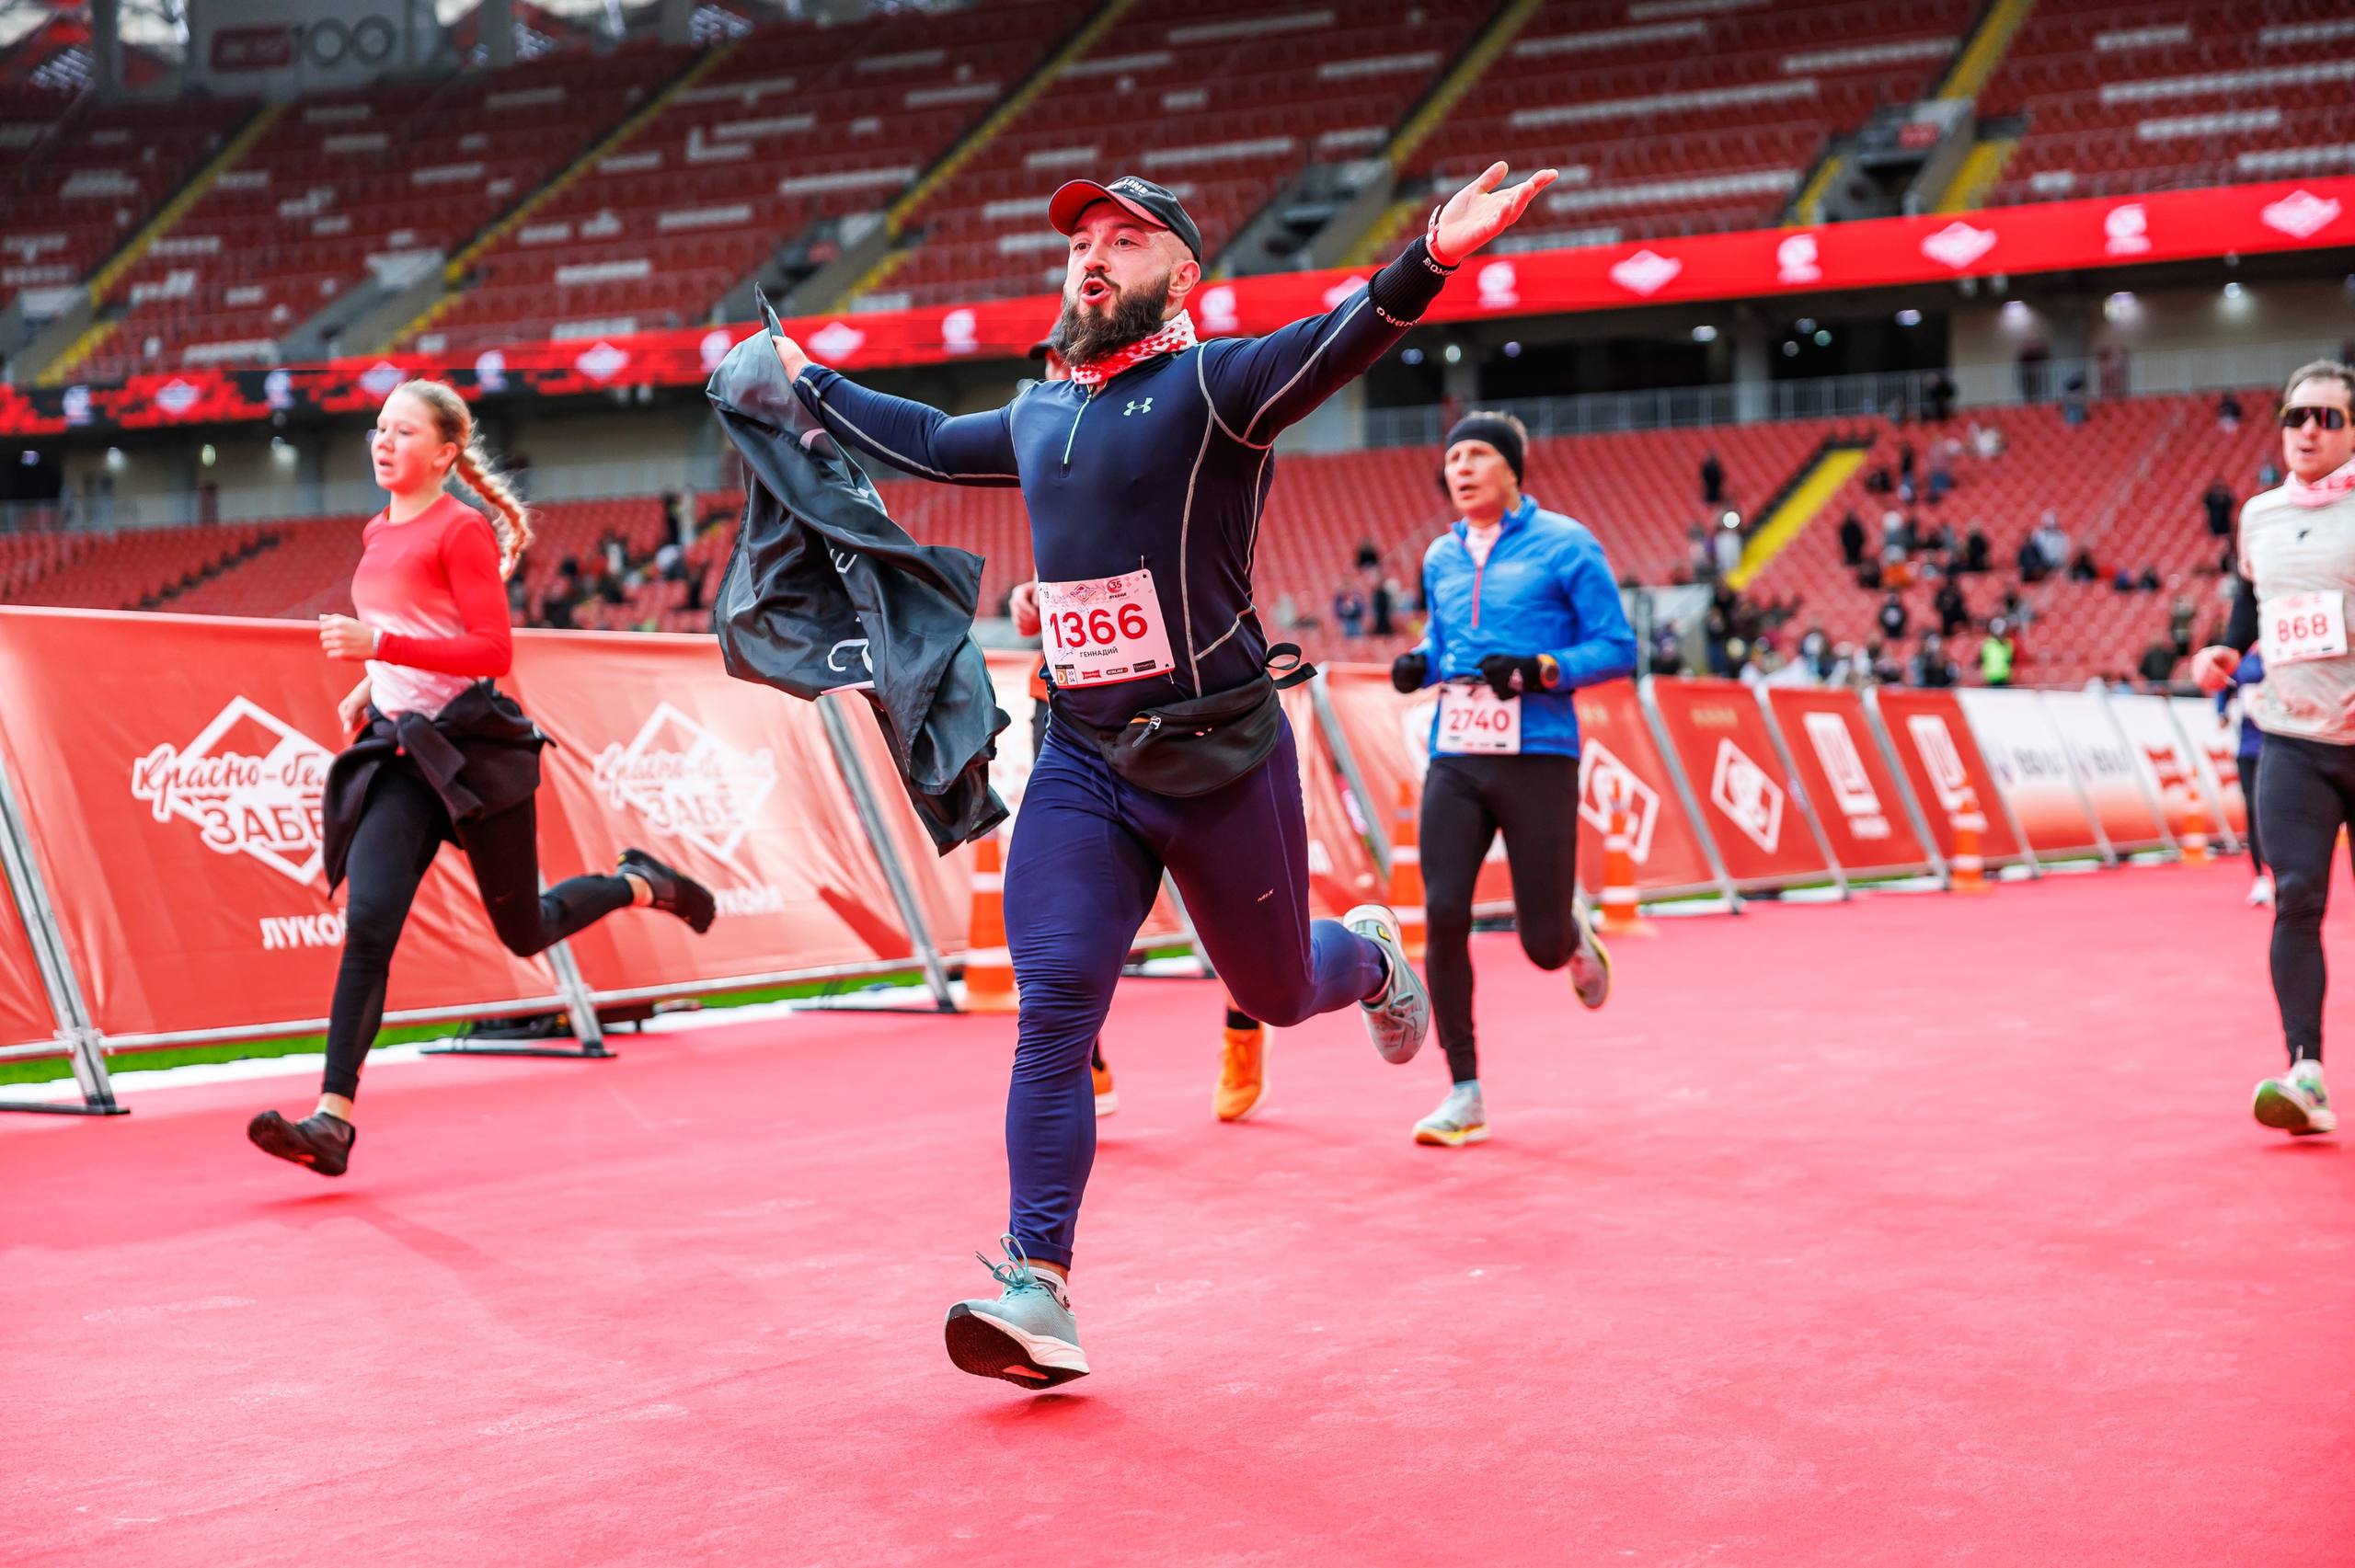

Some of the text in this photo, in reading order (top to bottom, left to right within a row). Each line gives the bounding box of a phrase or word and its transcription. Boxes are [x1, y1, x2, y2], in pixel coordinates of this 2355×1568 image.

[1050, 603, 1148, 647] 1366
[2278, 612, 2327, 642] 868
[1079, 647, 1119, 658] ГЕННАДИЙ
[1449, 708, 1511, 732] 2740
[136, 749, 324, 816] Красно-бе
[203, 804, 324, 845] ЗАБЕ
